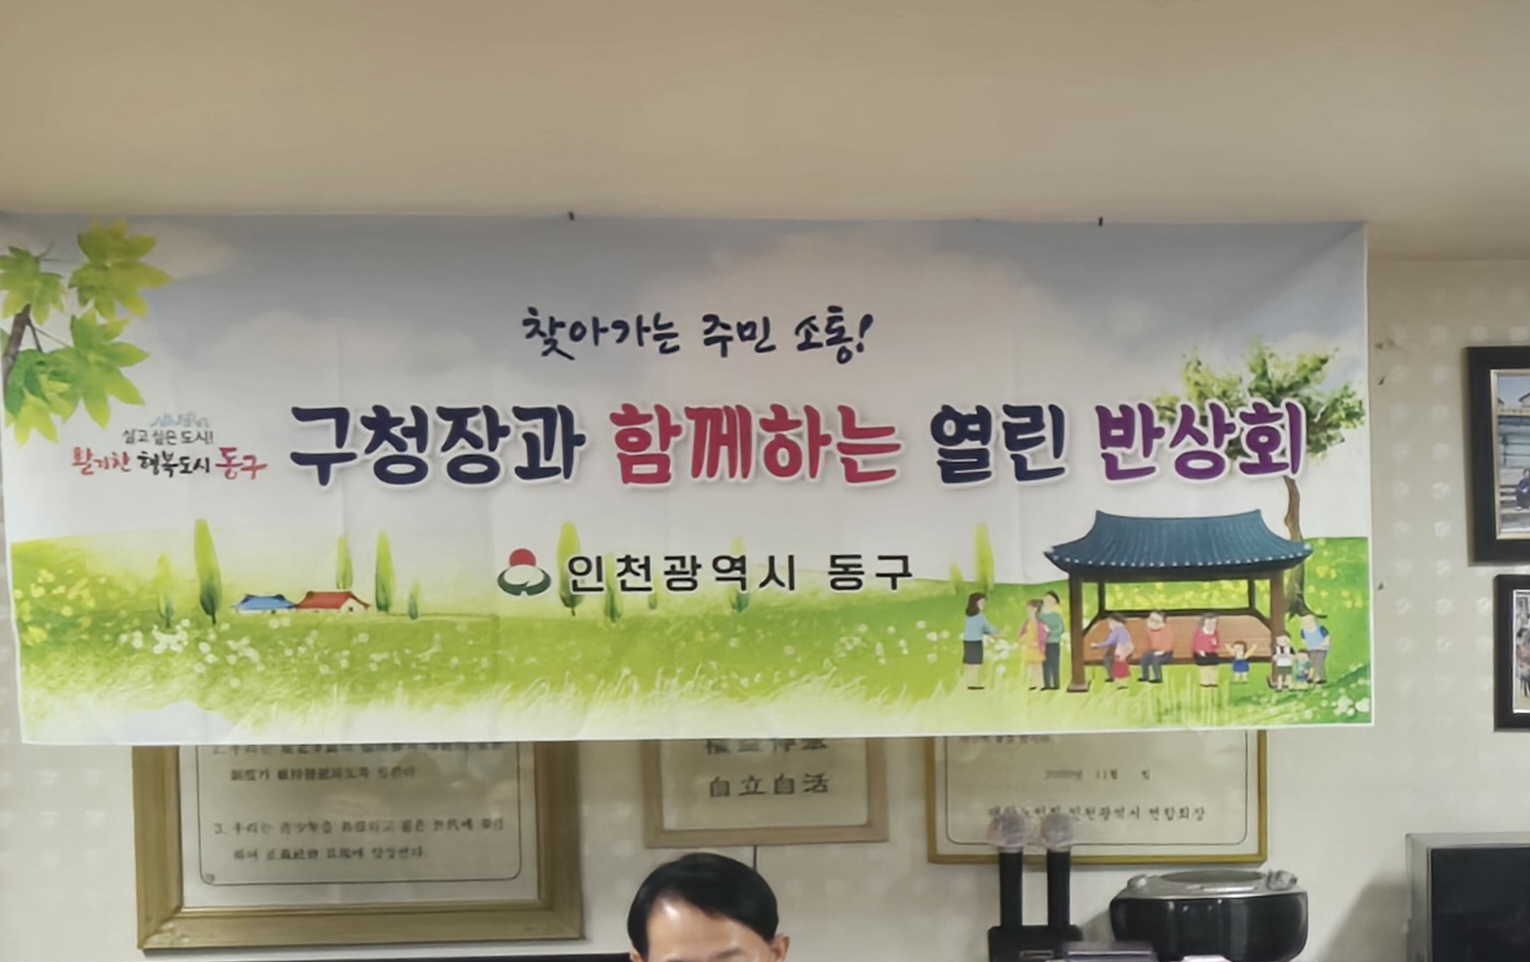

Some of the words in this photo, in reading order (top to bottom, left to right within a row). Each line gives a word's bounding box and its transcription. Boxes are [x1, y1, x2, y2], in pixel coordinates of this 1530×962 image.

[521, 306, 681, 361] 찾아가는
[701, 313, 777, 358] 주민
[794, 304, 874, 365] 소통!
[72, 446, 131, 475] 활기찬
[137, 451, 211, 478] 행복도시
[215, 446, 269, 480] 동구
[290, 404, 587, 486] 구청장과
[611, 404, 900, 484] 함께하는
[930, 403, 1065, 484] 열린
[1095, 402, 1305, 481] 반상회
[568, 554, 795, 593] 인천광역시
[827, 554, 913, 591] 동구
